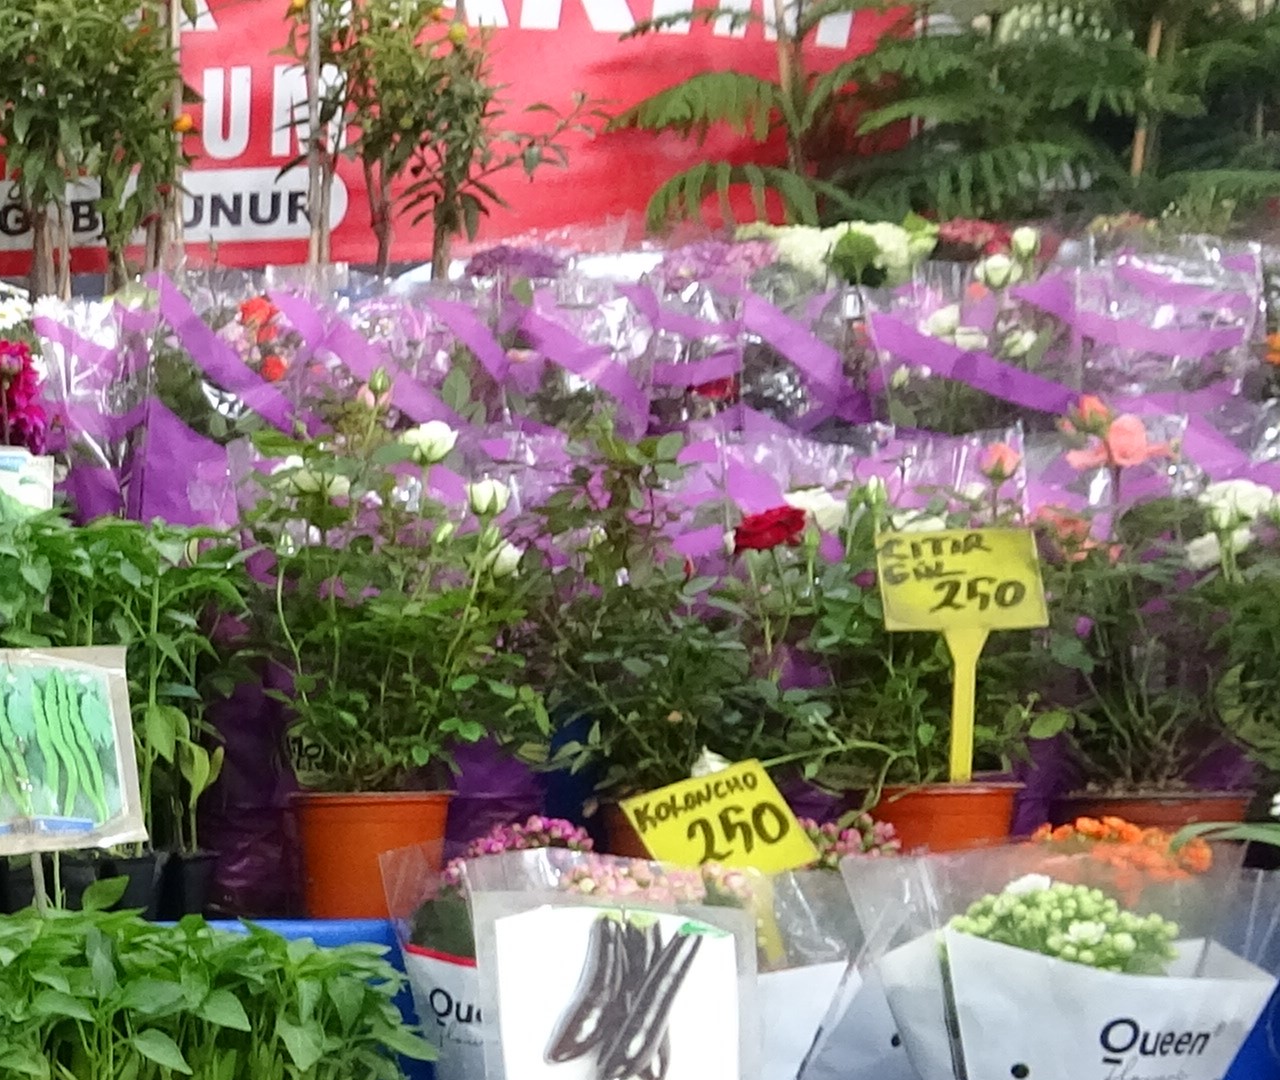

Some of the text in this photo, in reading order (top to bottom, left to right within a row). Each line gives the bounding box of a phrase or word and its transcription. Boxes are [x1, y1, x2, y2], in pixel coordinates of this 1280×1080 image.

[929, 576, 1026, 614] 250
[687, 802, 790, 865] 250
[1100, 1018, 1211, 1064] Queen
